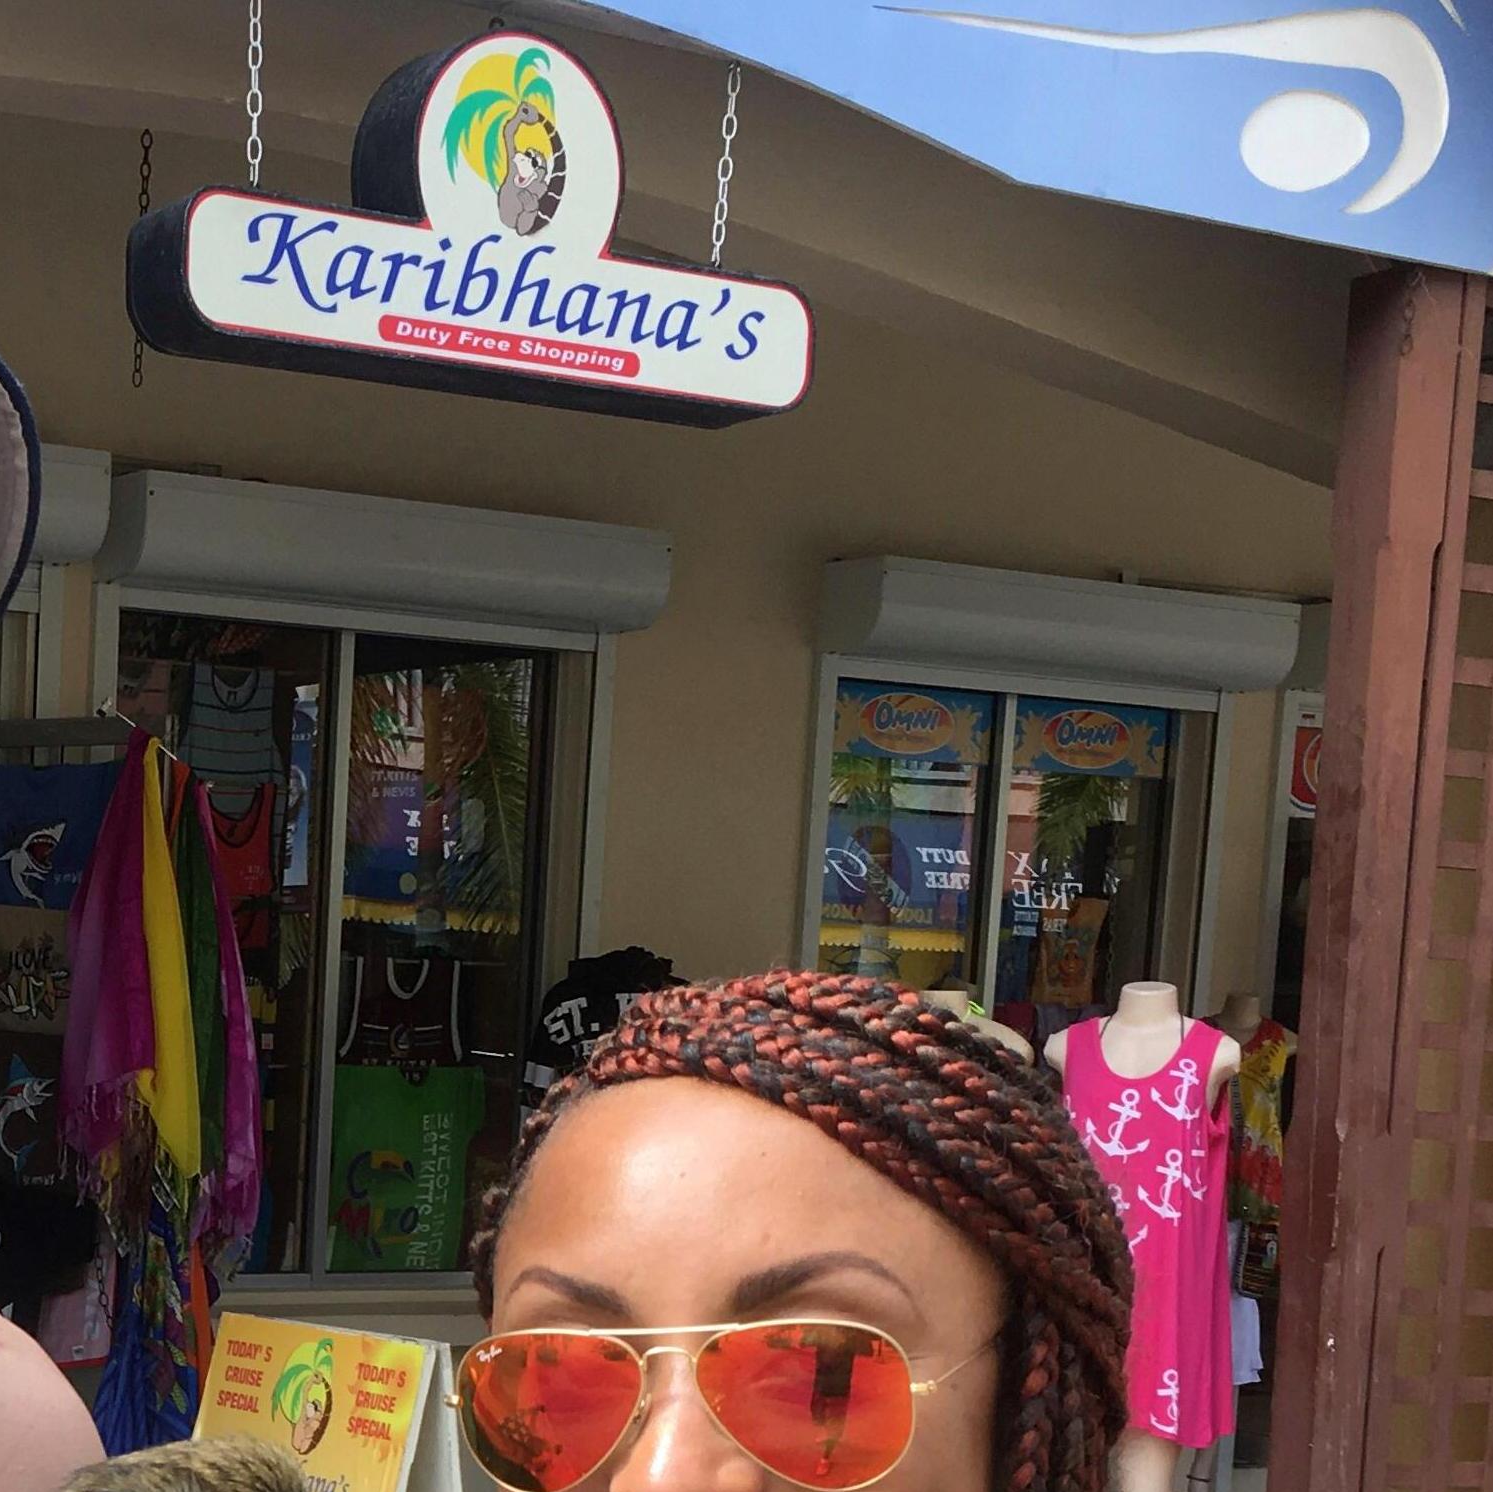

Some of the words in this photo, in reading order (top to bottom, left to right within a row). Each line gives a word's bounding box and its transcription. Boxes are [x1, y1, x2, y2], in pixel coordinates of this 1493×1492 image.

[241, 212, 766, 361] Karibhana's
[395, 321, 450, 345] Duty
[457, 330, 515, 353] Free
[518, 336, 626, 373] Shopping
[875, 700, 941, 732] OMNI
[1057, 718, 1119, 749] OMNI
[543, 996, 601, 1046] ST.
[225, 1365, 264, 1388] CRUISE
[217, 1389, 260, 1414] SPECIAL
[355, 1390, 397, 1414] CRUISE
[346, 1415, 392, 1441] SPECIAL
